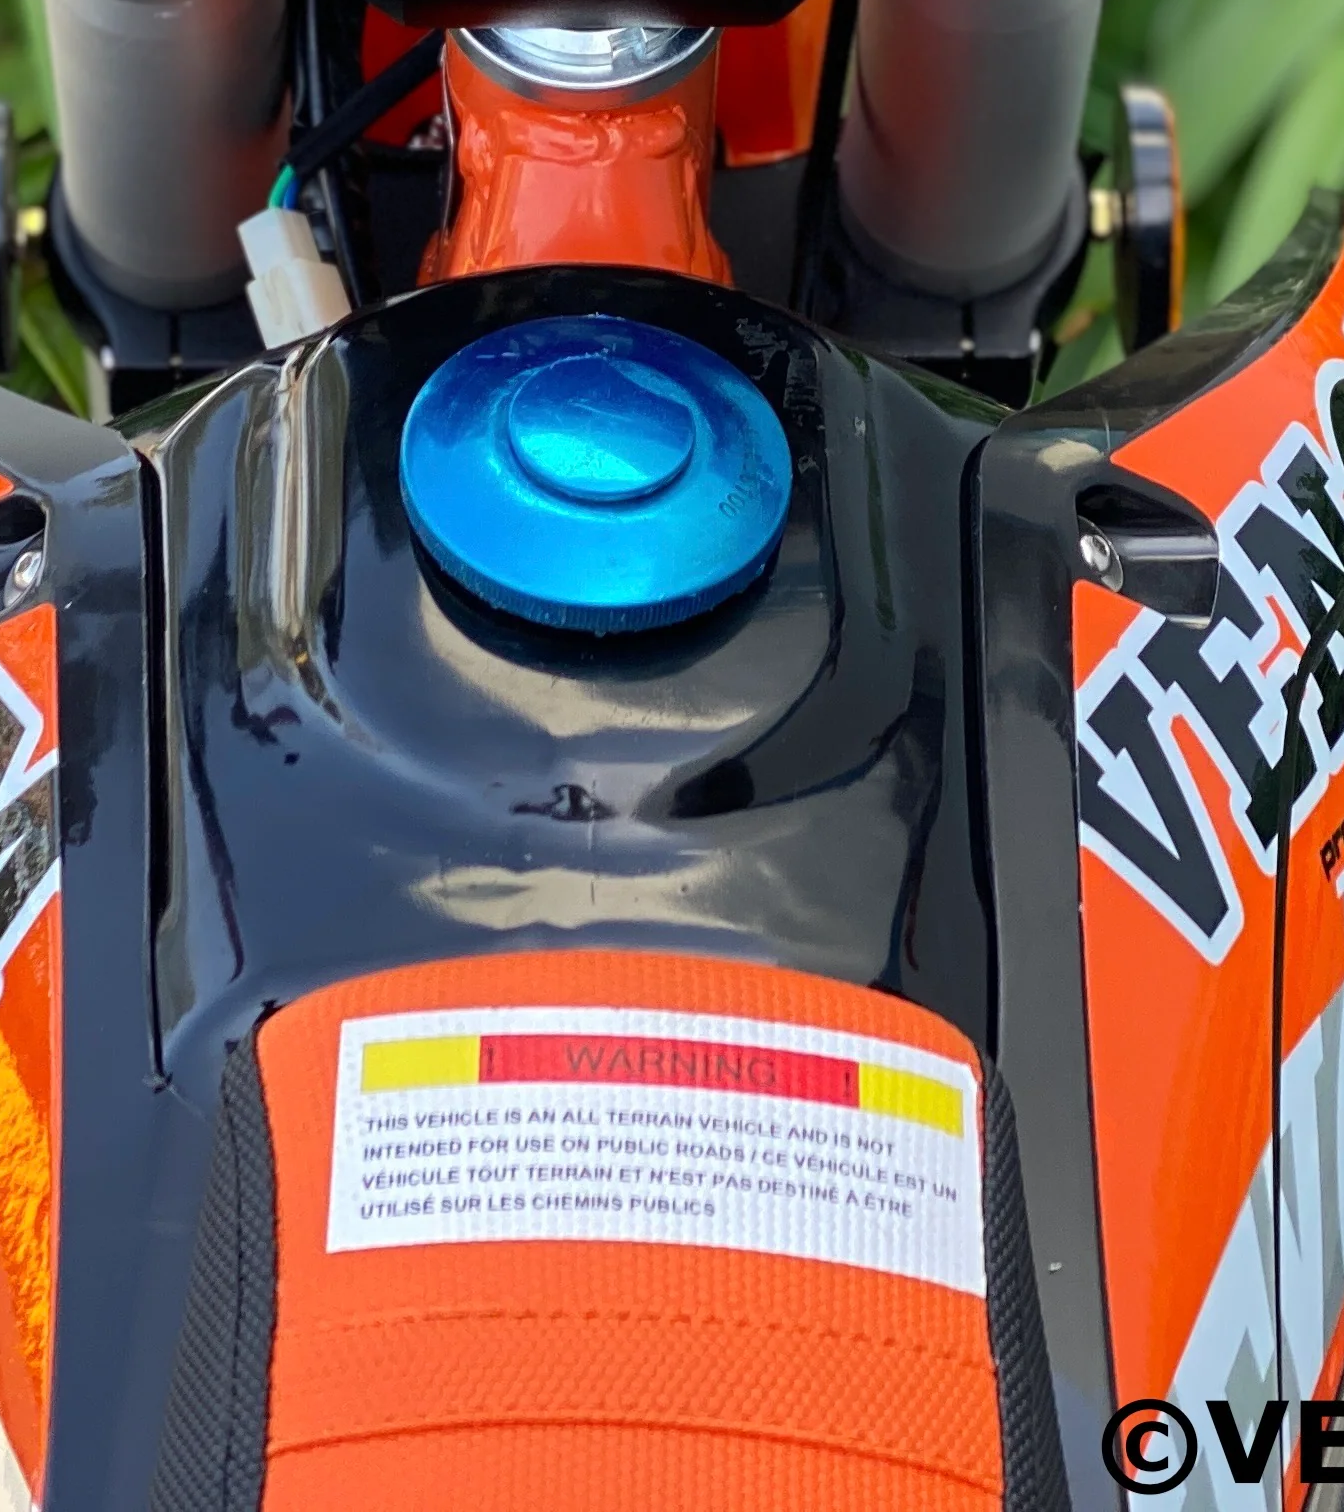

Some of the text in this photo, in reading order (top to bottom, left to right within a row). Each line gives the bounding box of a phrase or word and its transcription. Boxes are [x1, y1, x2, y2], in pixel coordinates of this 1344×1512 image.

[566, 1043, 776, 1087] WARNING
[367, 1108, 896, 1157] THIS VEHICLE IS AN ALL TERRAIN VEHICLE AND IS NOT
[362, 1139, 462, 1162] INTENDED
[468, 1138, 509, 1154] FOR
[515, 1137, 556, 1154] USE
[560, 1138, 590, 1154] ON
[597, 1138, 670, 1156] PUBLIC
[676, 1141, 745, 1163] ROADS
[762, 1149, 788, 1167] CE
[794, 1150, 888, 1182] VÉHICULE
[894, 1173, 927, 1194] EST
[933, 1182, 958, 1203] UN
[362, 1165, 461, 1191] VÉHICULE
[467, 1166, 519, 1183] TOUT
[527, 1165, 612, 1182] TERRAIN
[619, 1167, 642, 1183] ET
[650, 1169, 707, 1187] N'EST
[713, 1173, 752, 1191] PAS
[758, 1178, 839, 1205] DESTINÉ
[360, 1192, 716, 1220] UTILISÉ SUR LES CHEMINS PUBLICS
